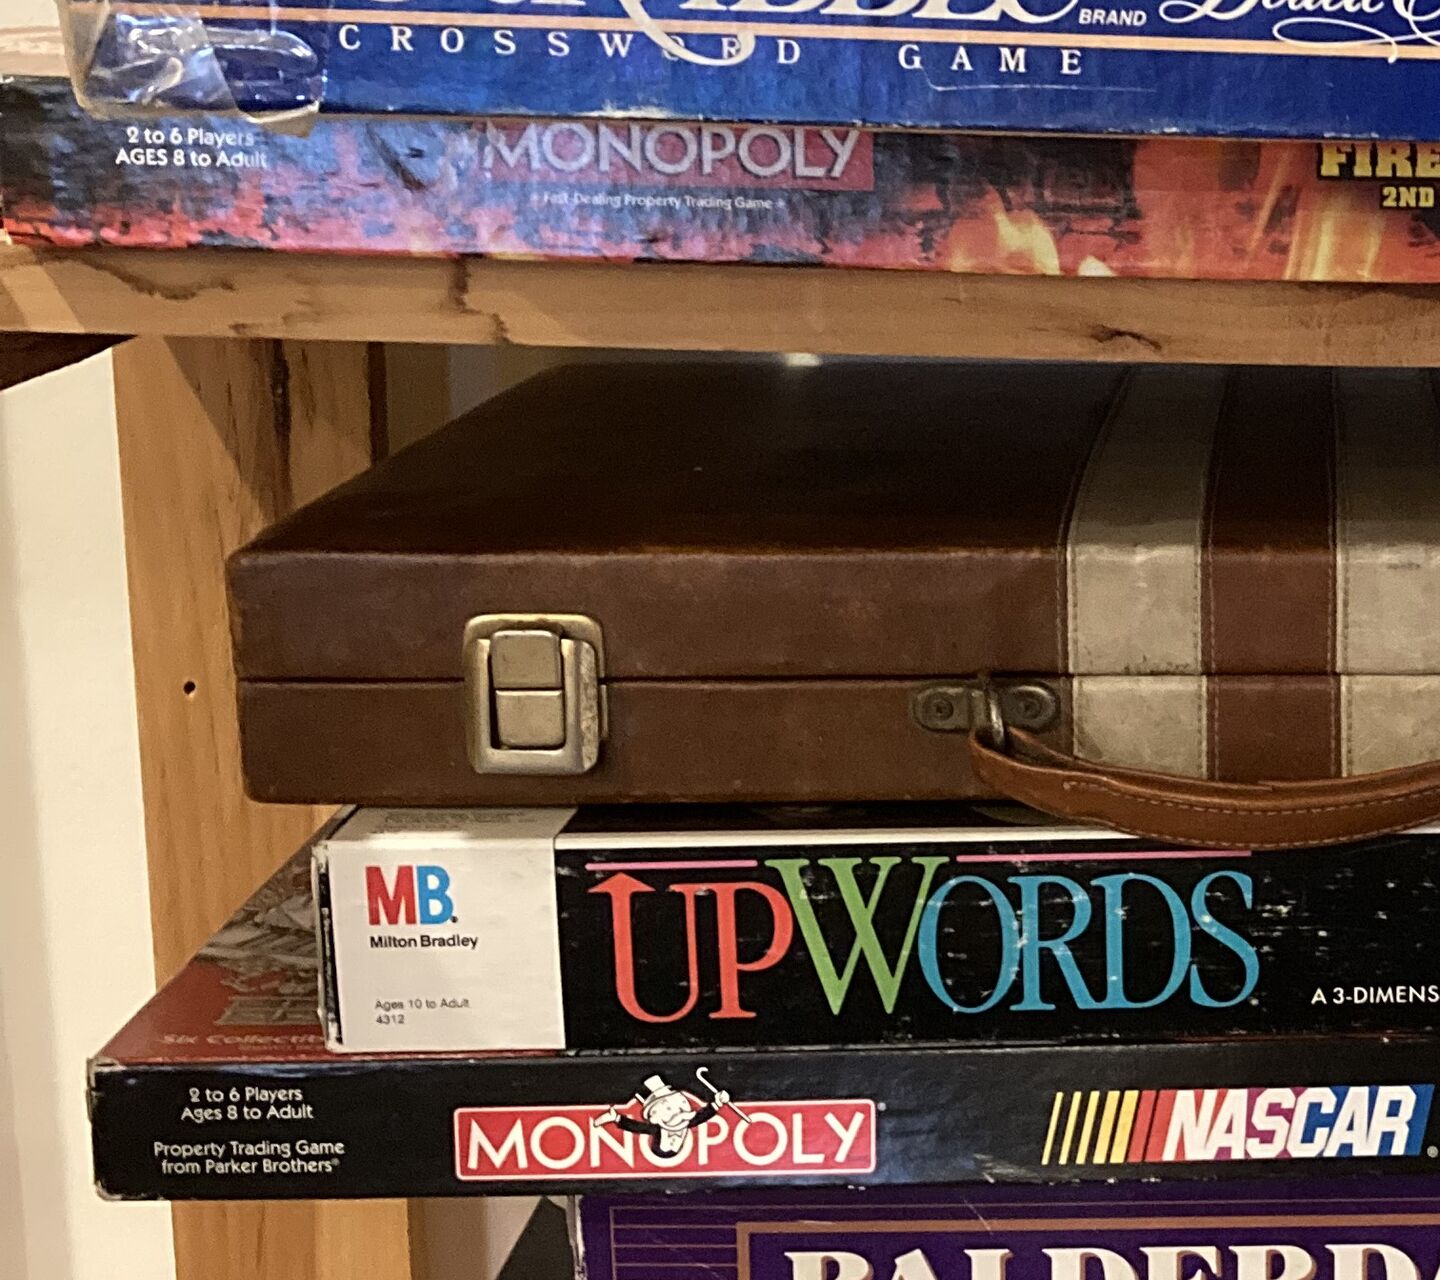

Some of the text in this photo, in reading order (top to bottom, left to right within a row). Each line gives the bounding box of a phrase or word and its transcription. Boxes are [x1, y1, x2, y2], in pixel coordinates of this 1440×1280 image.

[1079, 8, 1147, 27] BRAND
[898, 43, 1083, 75] GAME
[128, 127, 254, 149] 2 to 6 Players
[116, 148, 268, 168] AGES 8 to Adult
[483, 122, 860, 179] MONOPOLY
[624, 194, 773, 210] Property Trading Game
[1382, 187, 1435, 208] 2ND
[370, 934, 479, 951] Milton Bradley
[587, 856, 1260, 1024] UPWORDS
[375, 998, 470, 1012] Ages 10 to Adult
[1311, 987, 1327, 1005] A
[376, 1014, 405, 1025] 4312
[189, 1086, 303, 1104] 2 to 6 Players
[181, 1104, 314, 1123] Ages 8 to Adult
[1162, 1086, 1420, 1160] NASCAR
[154, 1140, 345, 1158] Property Trading Game
[161, 1159, 200, 1175] from
[205, 1158, 258, 1174] Parker
